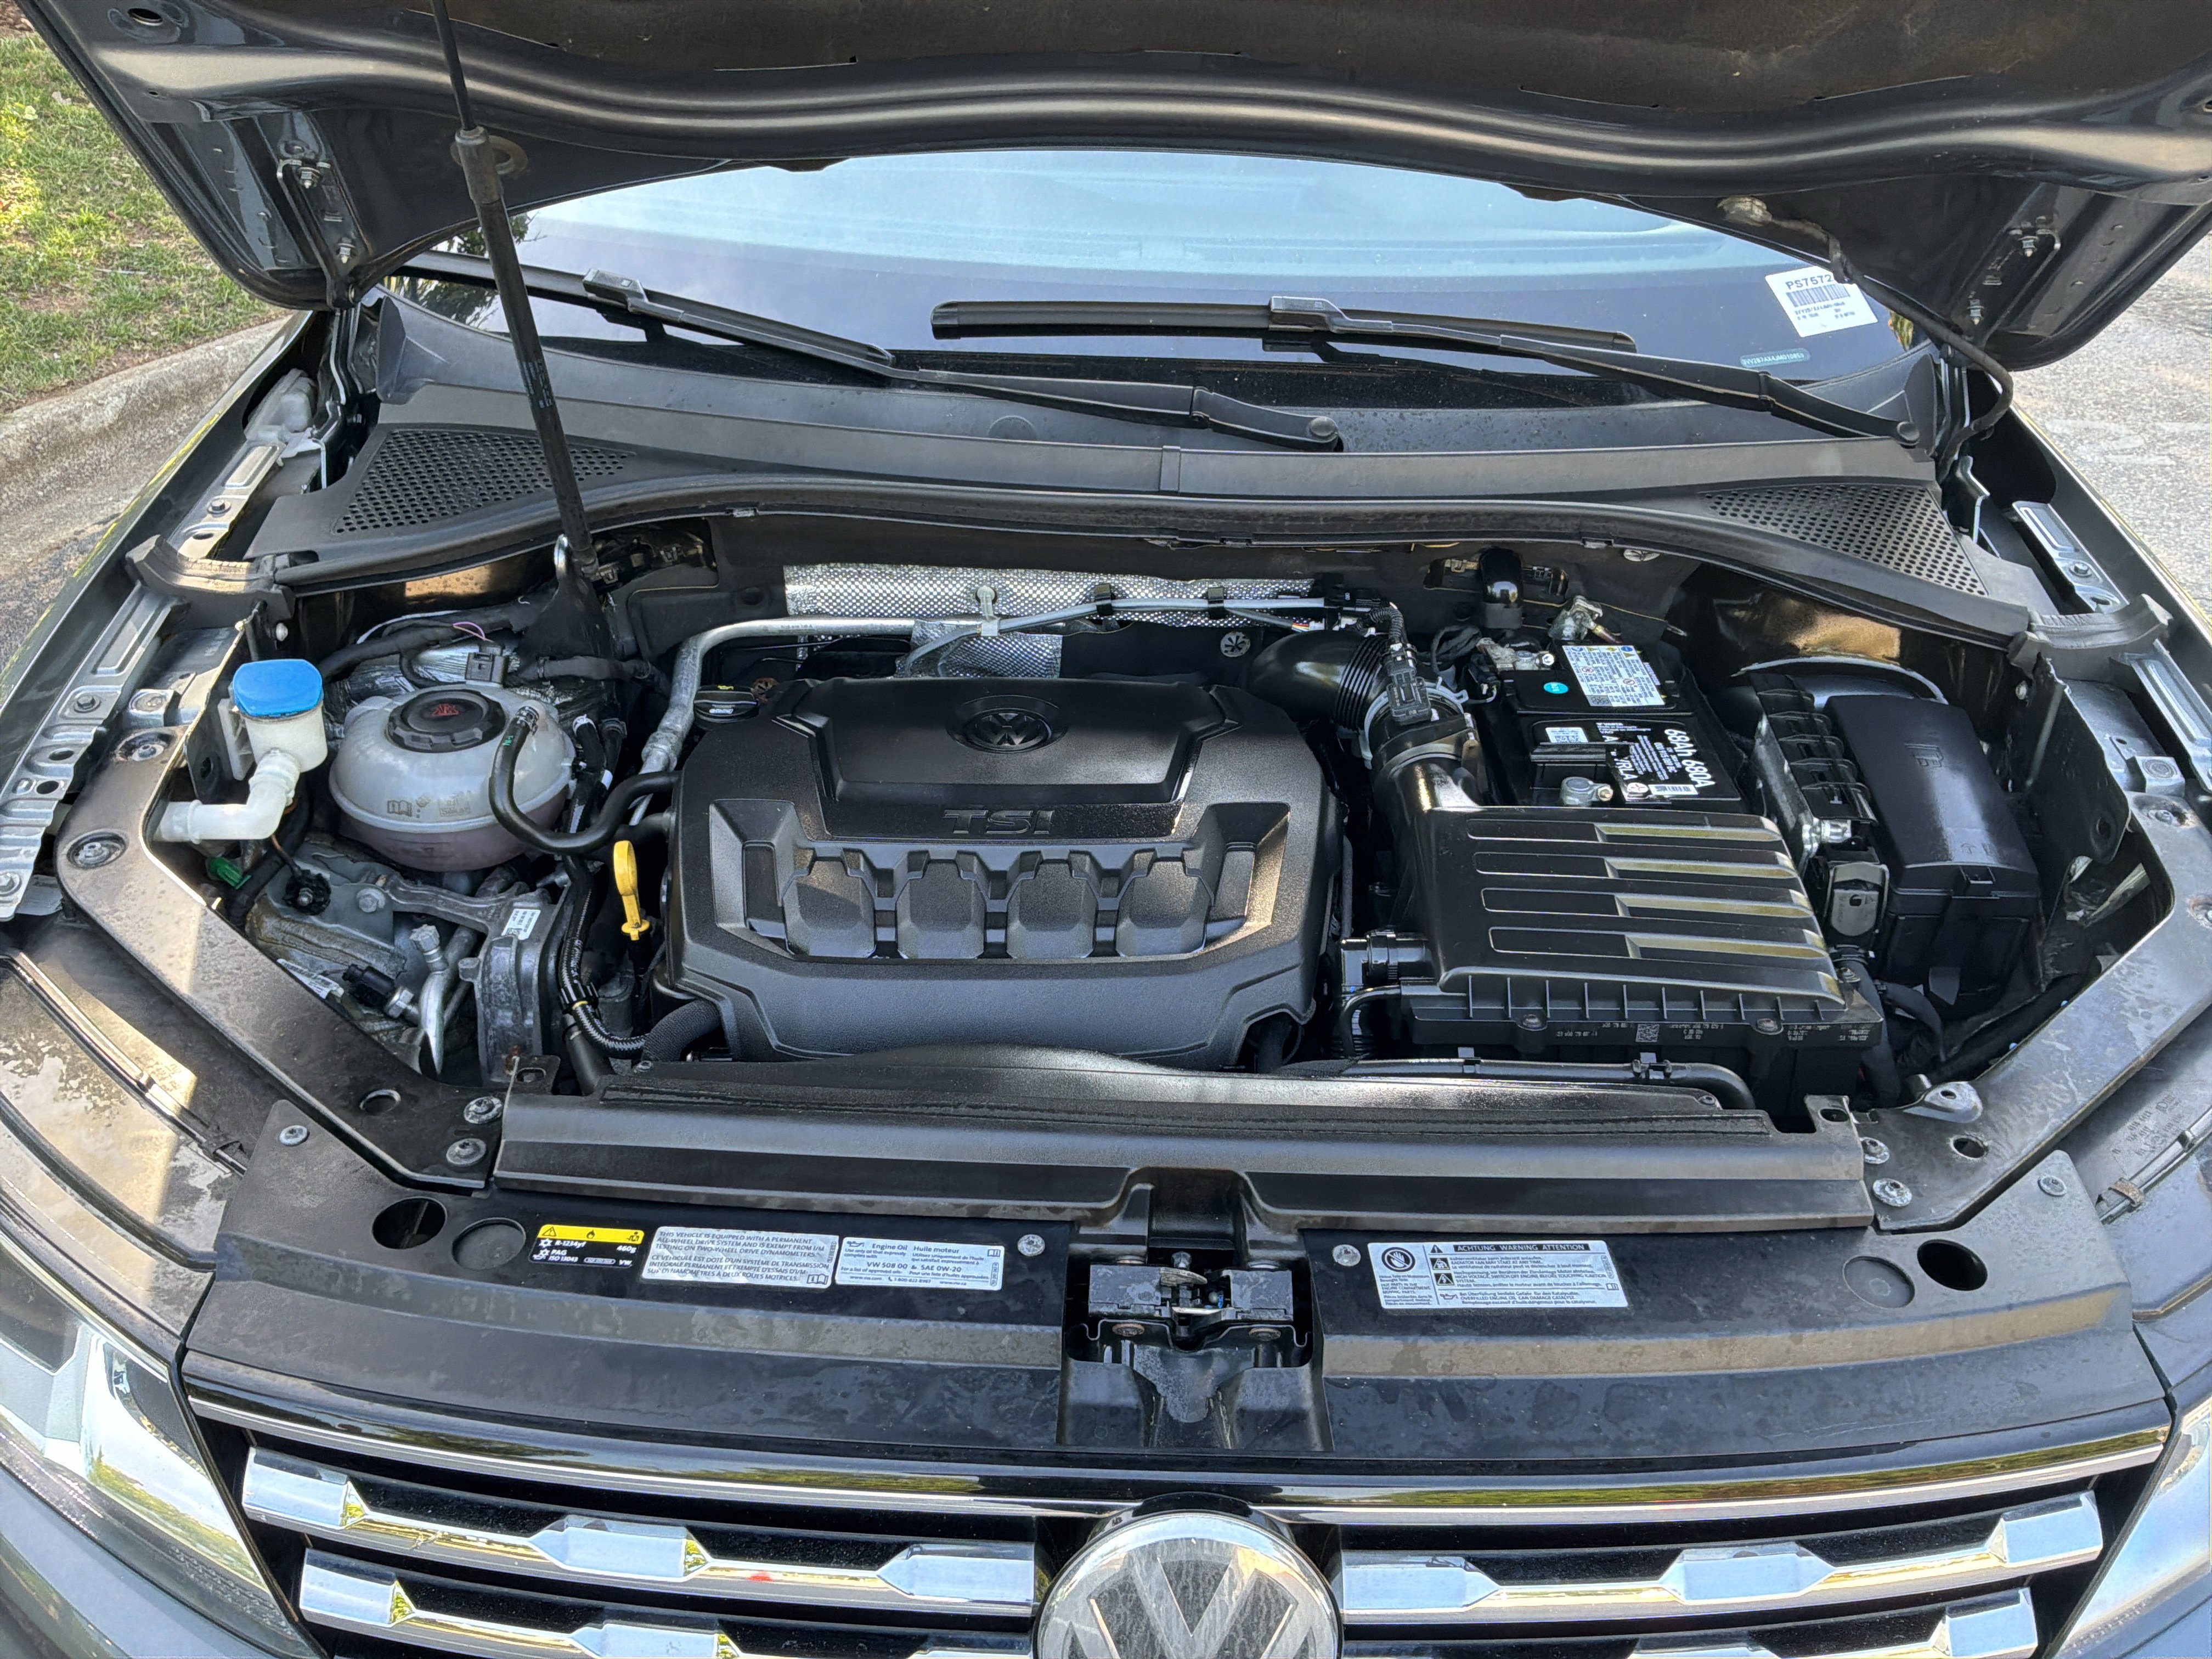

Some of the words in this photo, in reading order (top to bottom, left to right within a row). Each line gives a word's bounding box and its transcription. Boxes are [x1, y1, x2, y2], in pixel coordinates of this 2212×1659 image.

[1664, 729, 1697, 757] 68Ah
[1681, 759, 1716, 788] 680A
[943, 809, 1054, 834] TSI
[555, 1240, 586, 1249] R-1234yf
